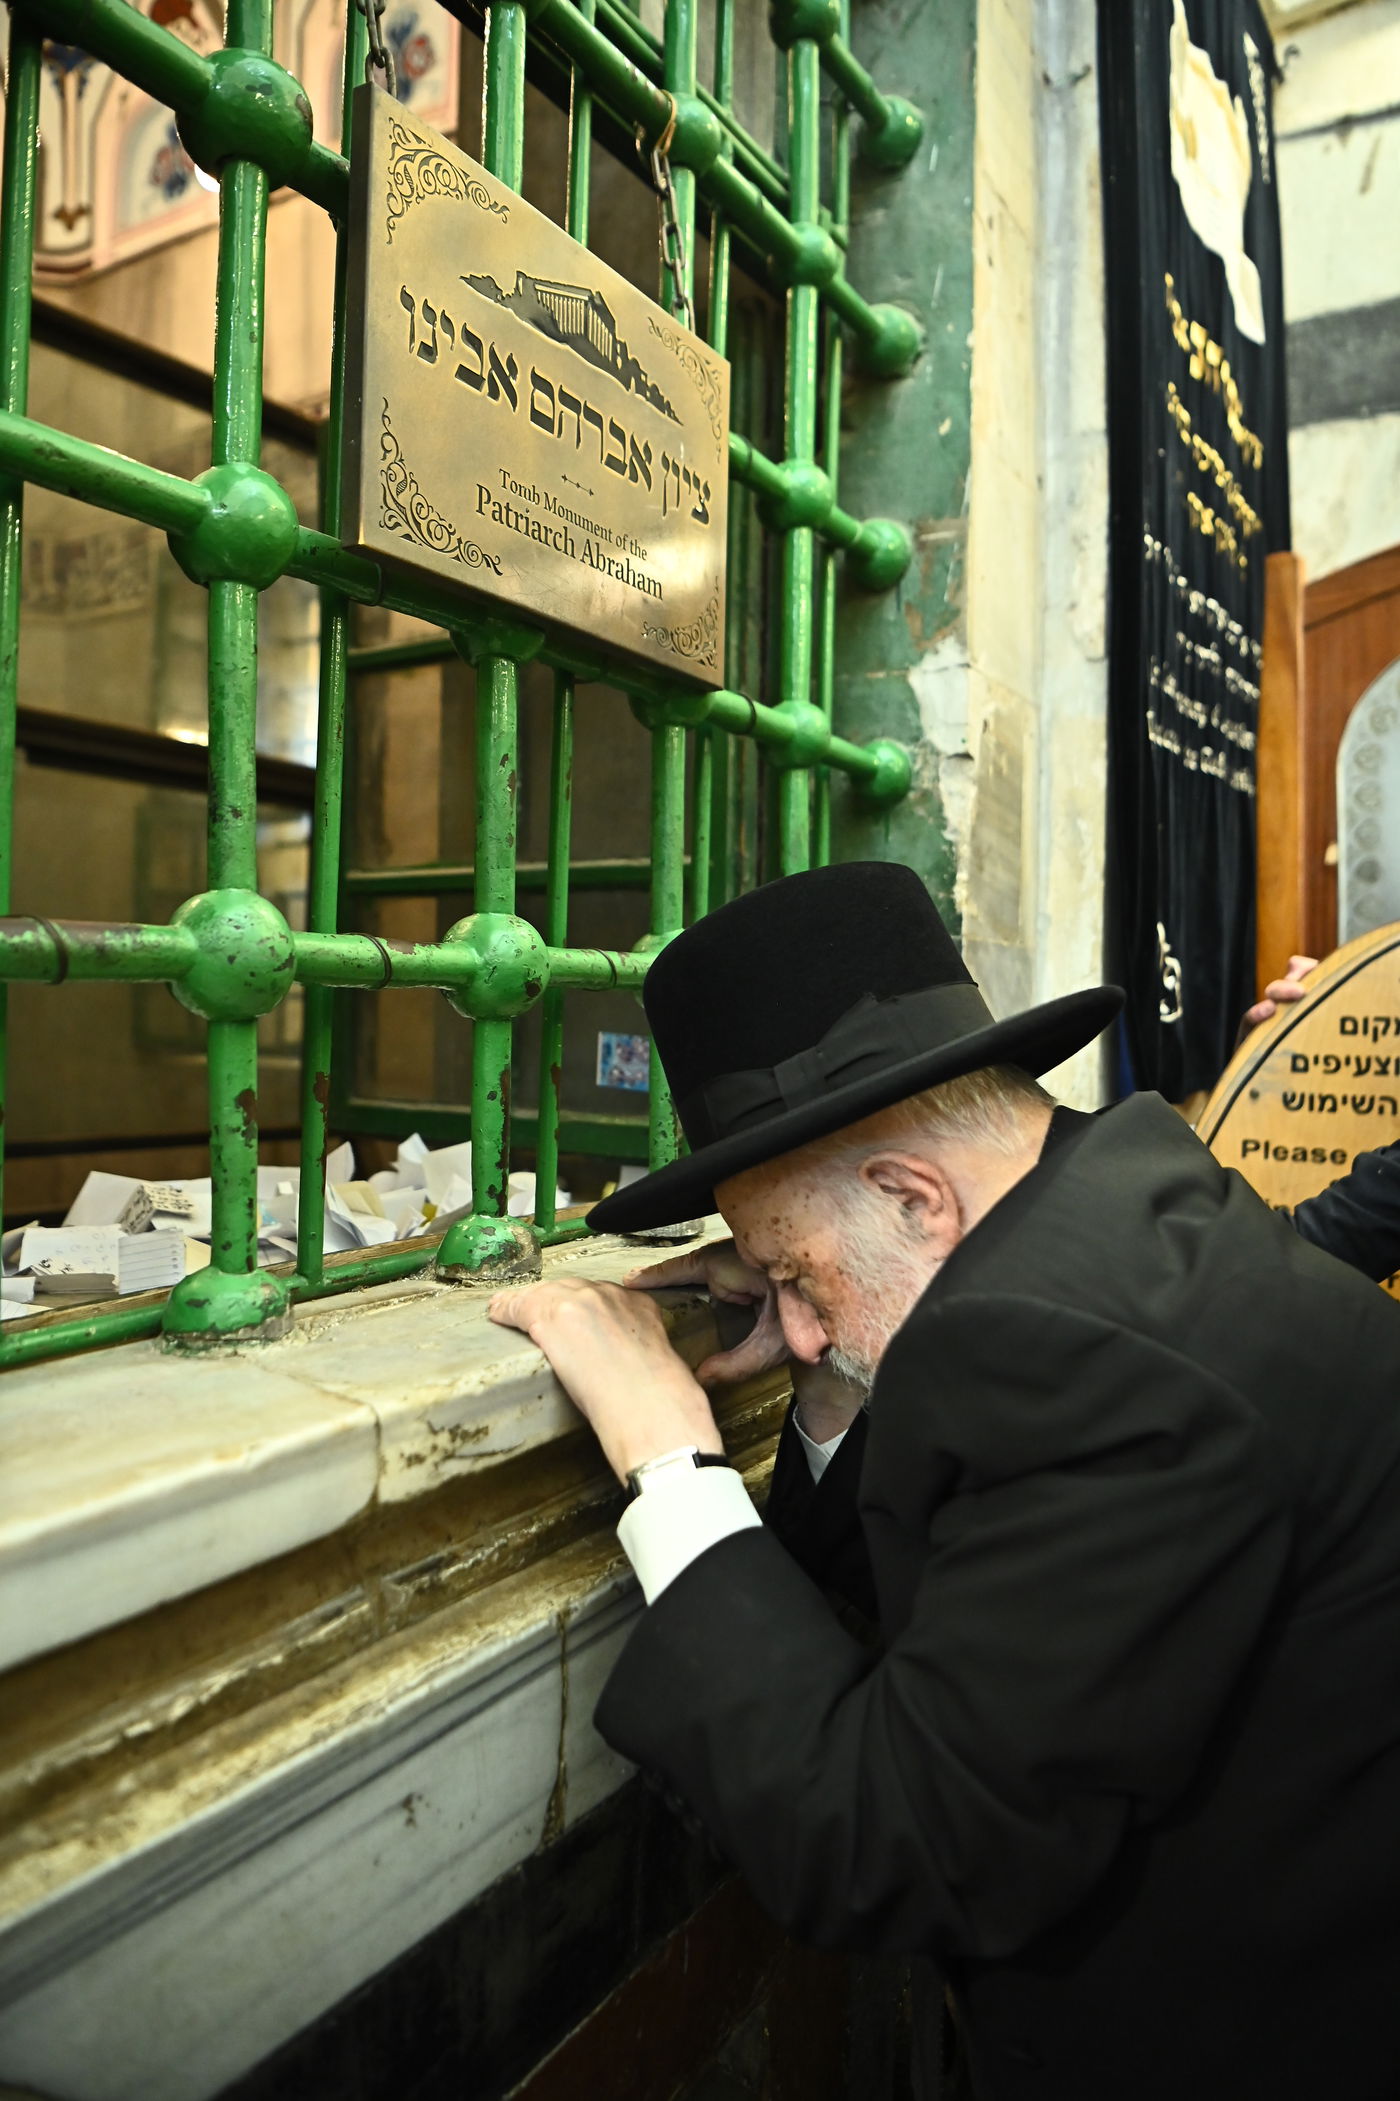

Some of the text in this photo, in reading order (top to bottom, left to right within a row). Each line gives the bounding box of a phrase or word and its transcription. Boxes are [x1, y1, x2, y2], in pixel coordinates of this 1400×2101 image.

[400, 285, 711, 524] ציון אברהם אבינו
[475, 483, 664, 600] Patriarch Abraham
[499, 468, 648, 561] Tomb Monument of the
[1282, 1090, 1398, 1117] השימוש
[1241, 1138, 1348, 1165] Please
